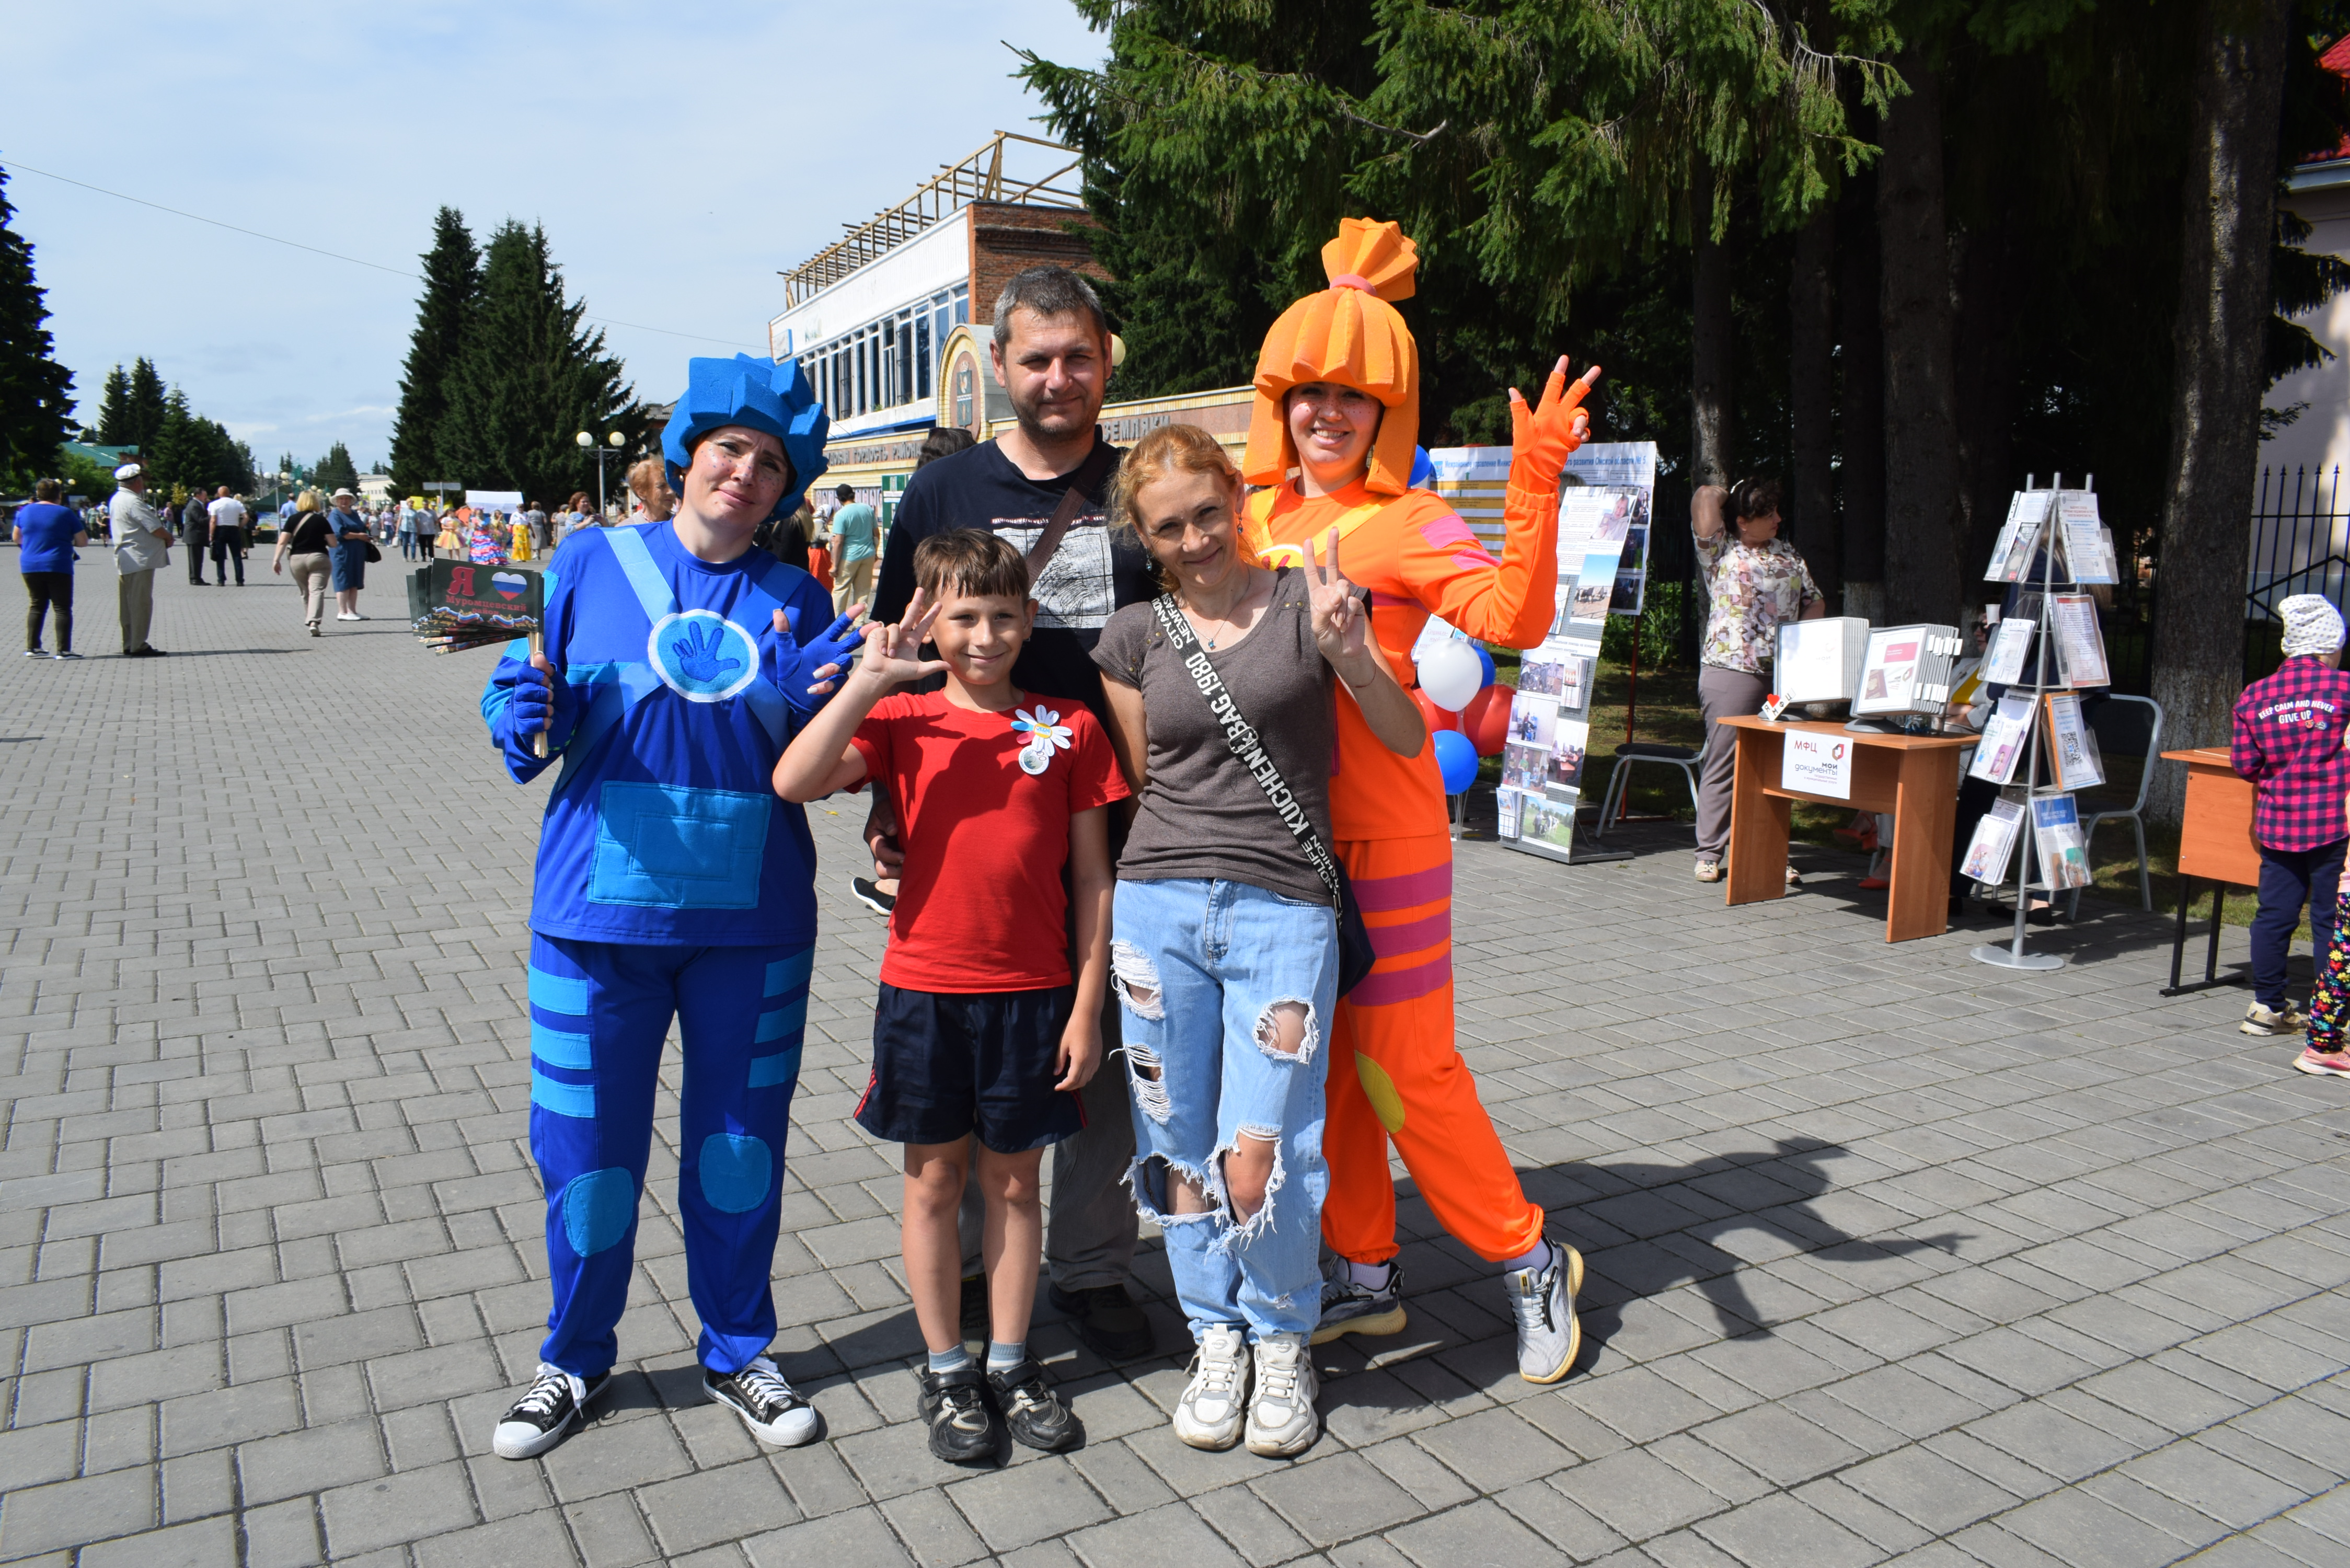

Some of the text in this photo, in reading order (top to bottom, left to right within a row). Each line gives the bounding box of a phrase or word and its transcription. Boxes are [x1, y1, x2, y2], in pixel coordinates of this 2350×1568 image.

[854, 446, 888, 464] ГОРДОСТЬ
[893, 442, 922, 460] РАЙОНА
[1472, 461, 1496, 469] управление
[1497, 458, 1512, 467] Минис
[1573, 459, 1594, 467] развития
[1595, 457, 1614, 465] Омской
[1615, 456, 1634, 465] области
[1643, 456, 1646, 464] 5
[447, 566, 476, 596] Я
[445, 595, 527, 612] Муромцевский
[1764, 704, 1770, 712] Я
[1772, 693, 1792, 716] МФЦ
[2258, 699, 2335, 720] KEEP CALM AND NEVER
[2278, 710, 2312, 724] GIVE UP
[1794, 740, 1817, 754] МФЦ
[1795, 764, 1838, 776] документы
